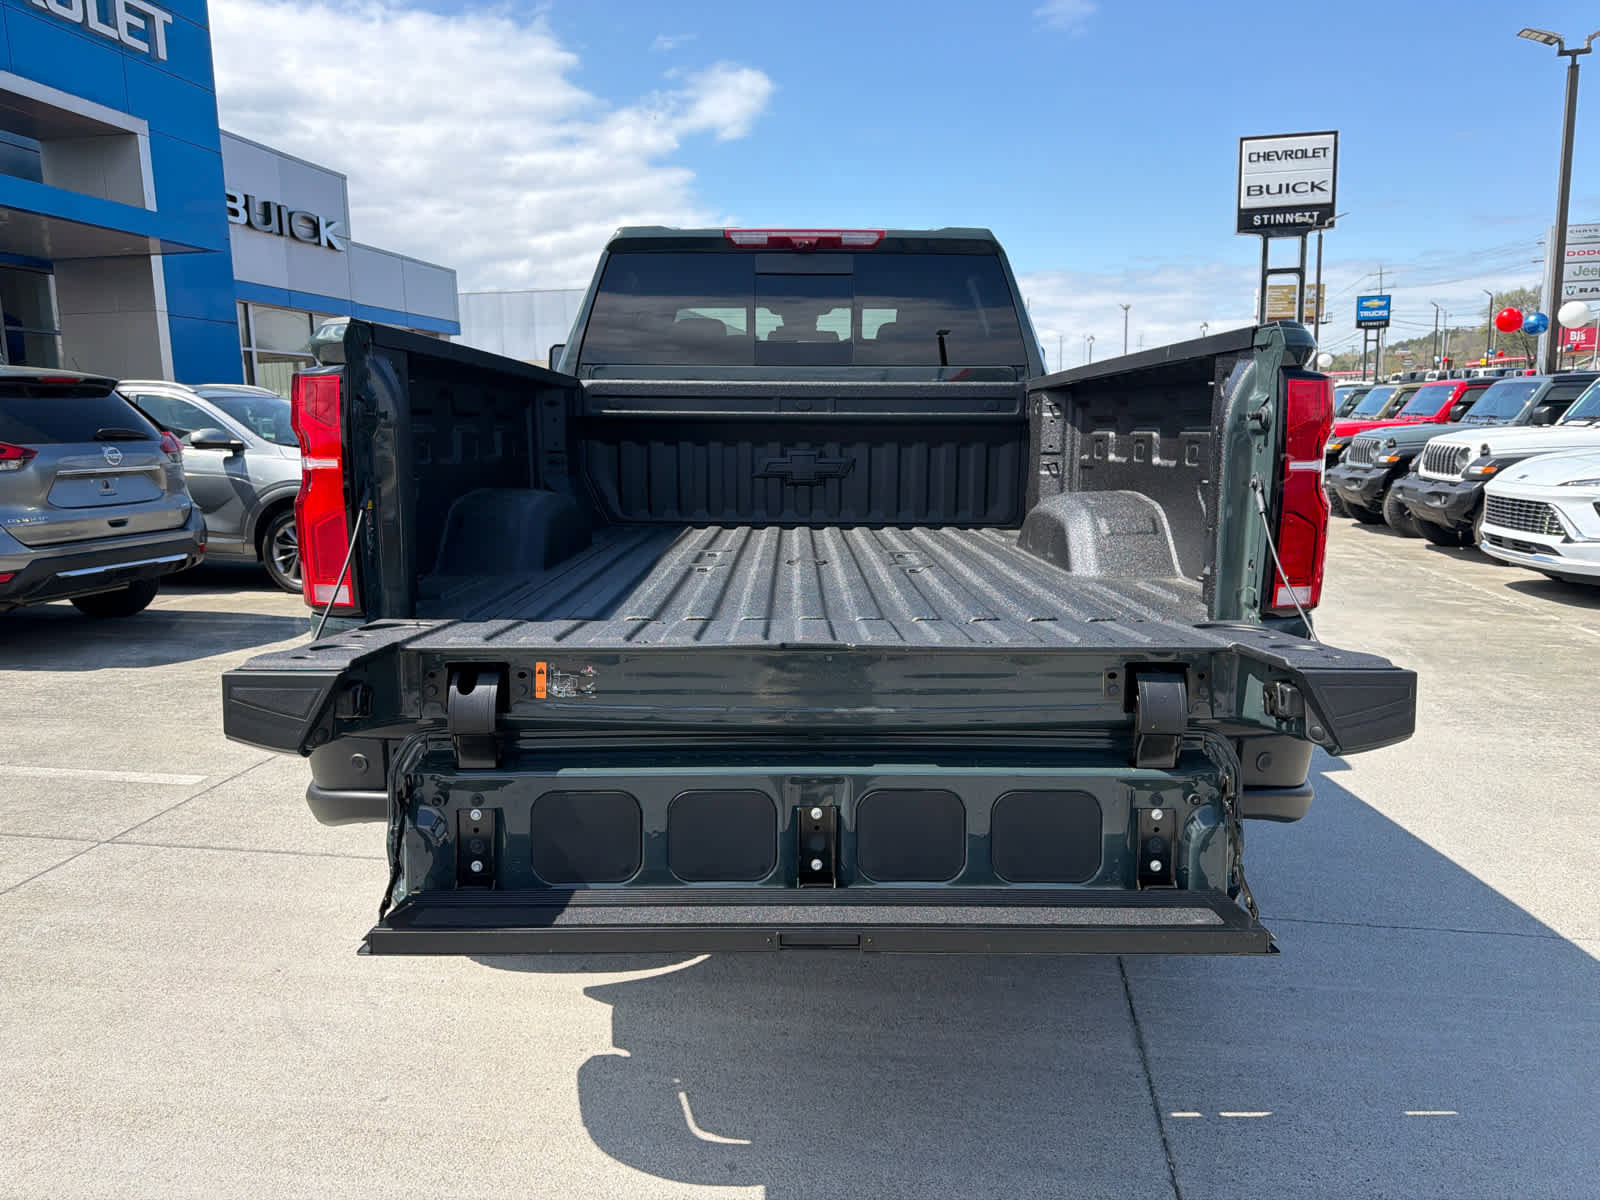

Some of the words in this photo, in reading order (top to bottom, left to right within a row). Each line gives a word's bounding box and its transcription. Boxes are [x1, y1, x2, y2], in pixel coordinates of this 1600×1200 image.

[31, 0, 173, 61] LET
[1248, 147, 1330, 163] CHEVROLET
[1246, 180, 1329, 197] BUICK
[226, 189, 345, 252] BUICK
[1360, 310, 1389, 318] TRUCKS
